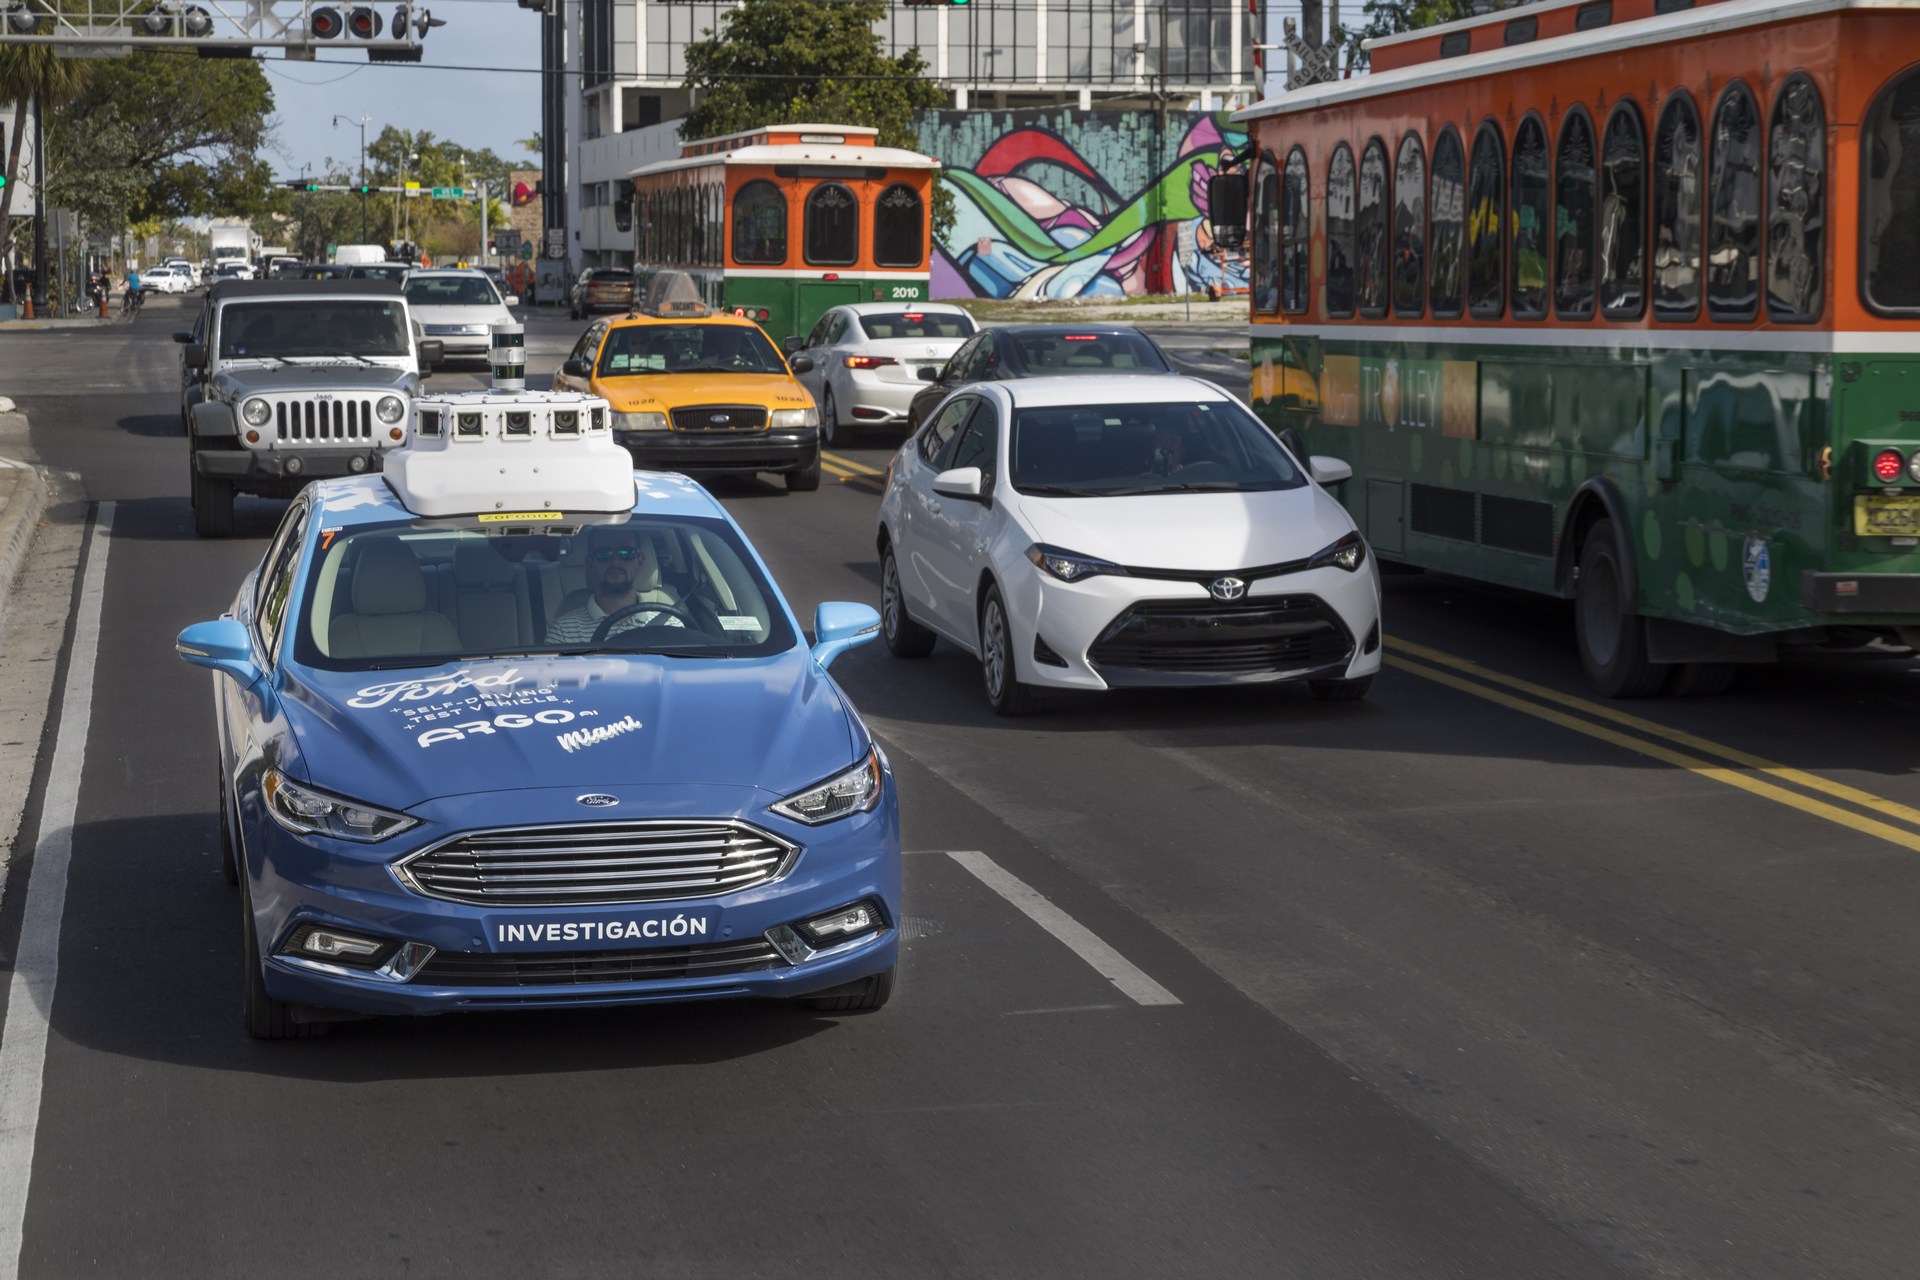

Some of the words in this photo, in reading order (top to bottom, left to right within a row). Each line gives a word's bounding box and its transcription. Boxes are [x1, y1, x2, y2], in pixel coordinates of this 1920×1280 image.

[1287, 40, 1337, 91] CROSSIN
[892, 286, 919, 298] 2010
[313, 393, 333, 401] Jeep
[628, 398, 655, 406] 1028
[321, 531, 335, 549] 7
[347, 668, 524, 708] Ford
[403, 689, 553, 717] SELF-DRIVING
[409, 708, 463, 724] TEST
[469, 695, 559, 712] VEHICLE
[417, 709, 575, 748] ARGO
[556, 715, 643, 753] Miami
[498, 914, 707, 942] INVESTIGACIÓN
